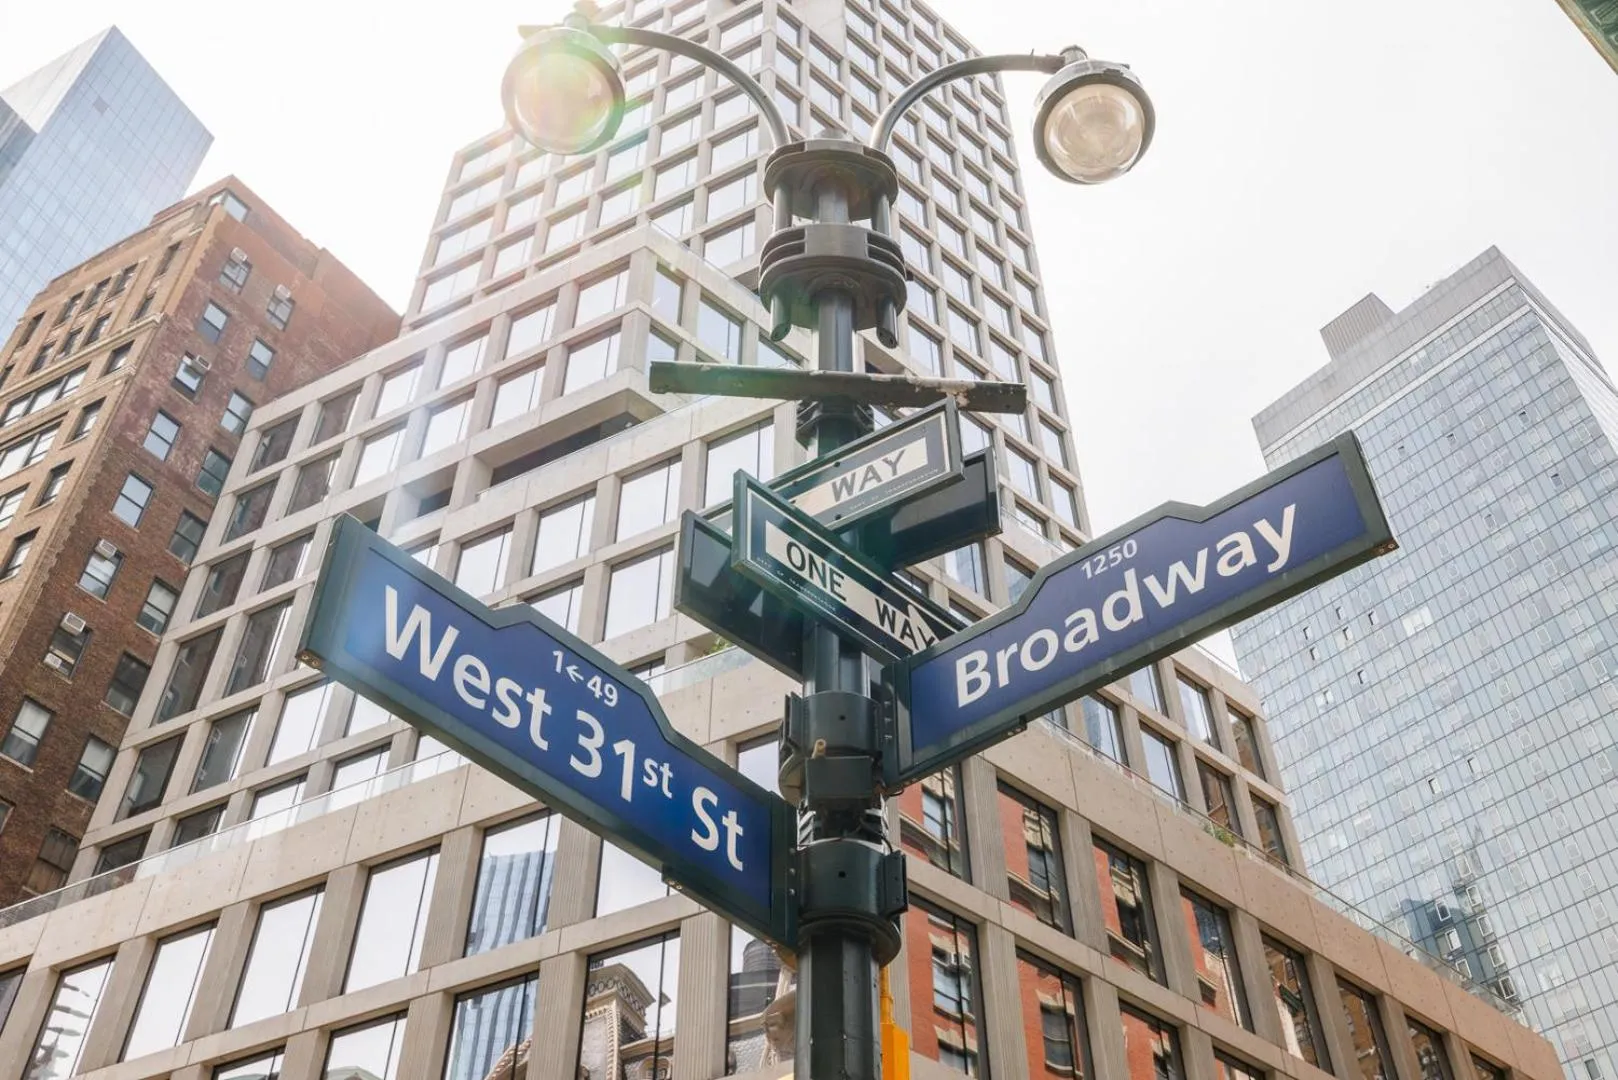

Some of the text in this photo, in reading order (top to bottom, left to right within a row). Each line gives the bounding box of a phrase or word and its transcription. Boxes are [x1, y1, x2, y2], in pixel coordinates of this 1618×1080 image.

[830, 448, 906, 502] WAY
[786, 540, 847, 602] ONE
[1081, 539, 1138, 580] 1250
[955, 503, 1297, 709] Broadway
[587, 675, 619, 708] 49
[384, 585, 744, 872] West 31st St
